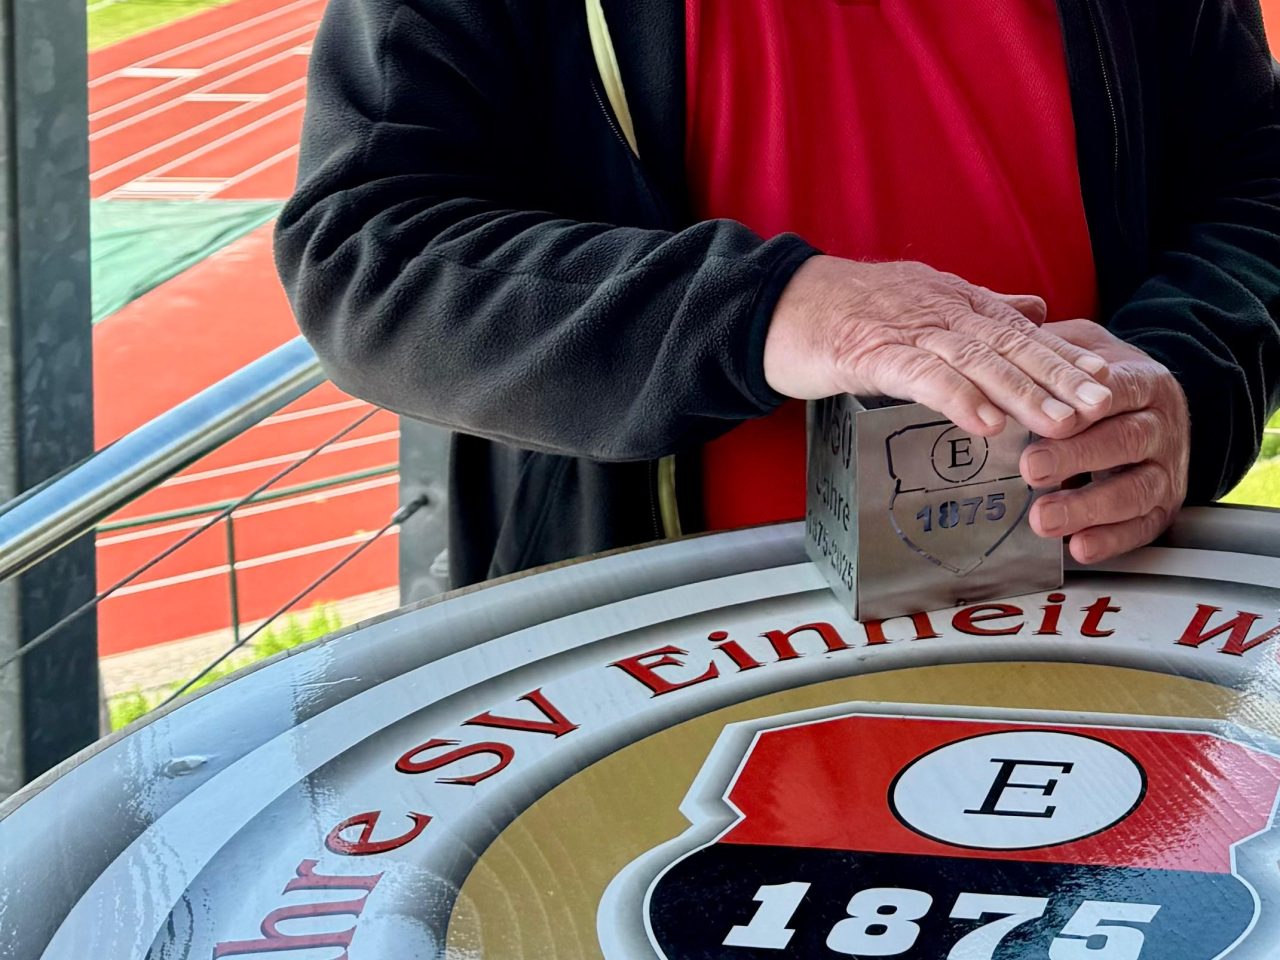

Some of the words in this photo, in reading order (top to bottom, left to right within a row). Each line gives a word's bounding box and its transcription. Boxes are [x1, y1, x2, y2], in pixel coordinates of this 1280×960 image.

[946, 437, 975, 470] E
[915, 492, 1008, 533] 1875
[962, 757, 1075, 820] E
[212, 809, 434, 960] hre
[394, 686, 581, 787] SV
[720, 881, 1163, 960] 1875
